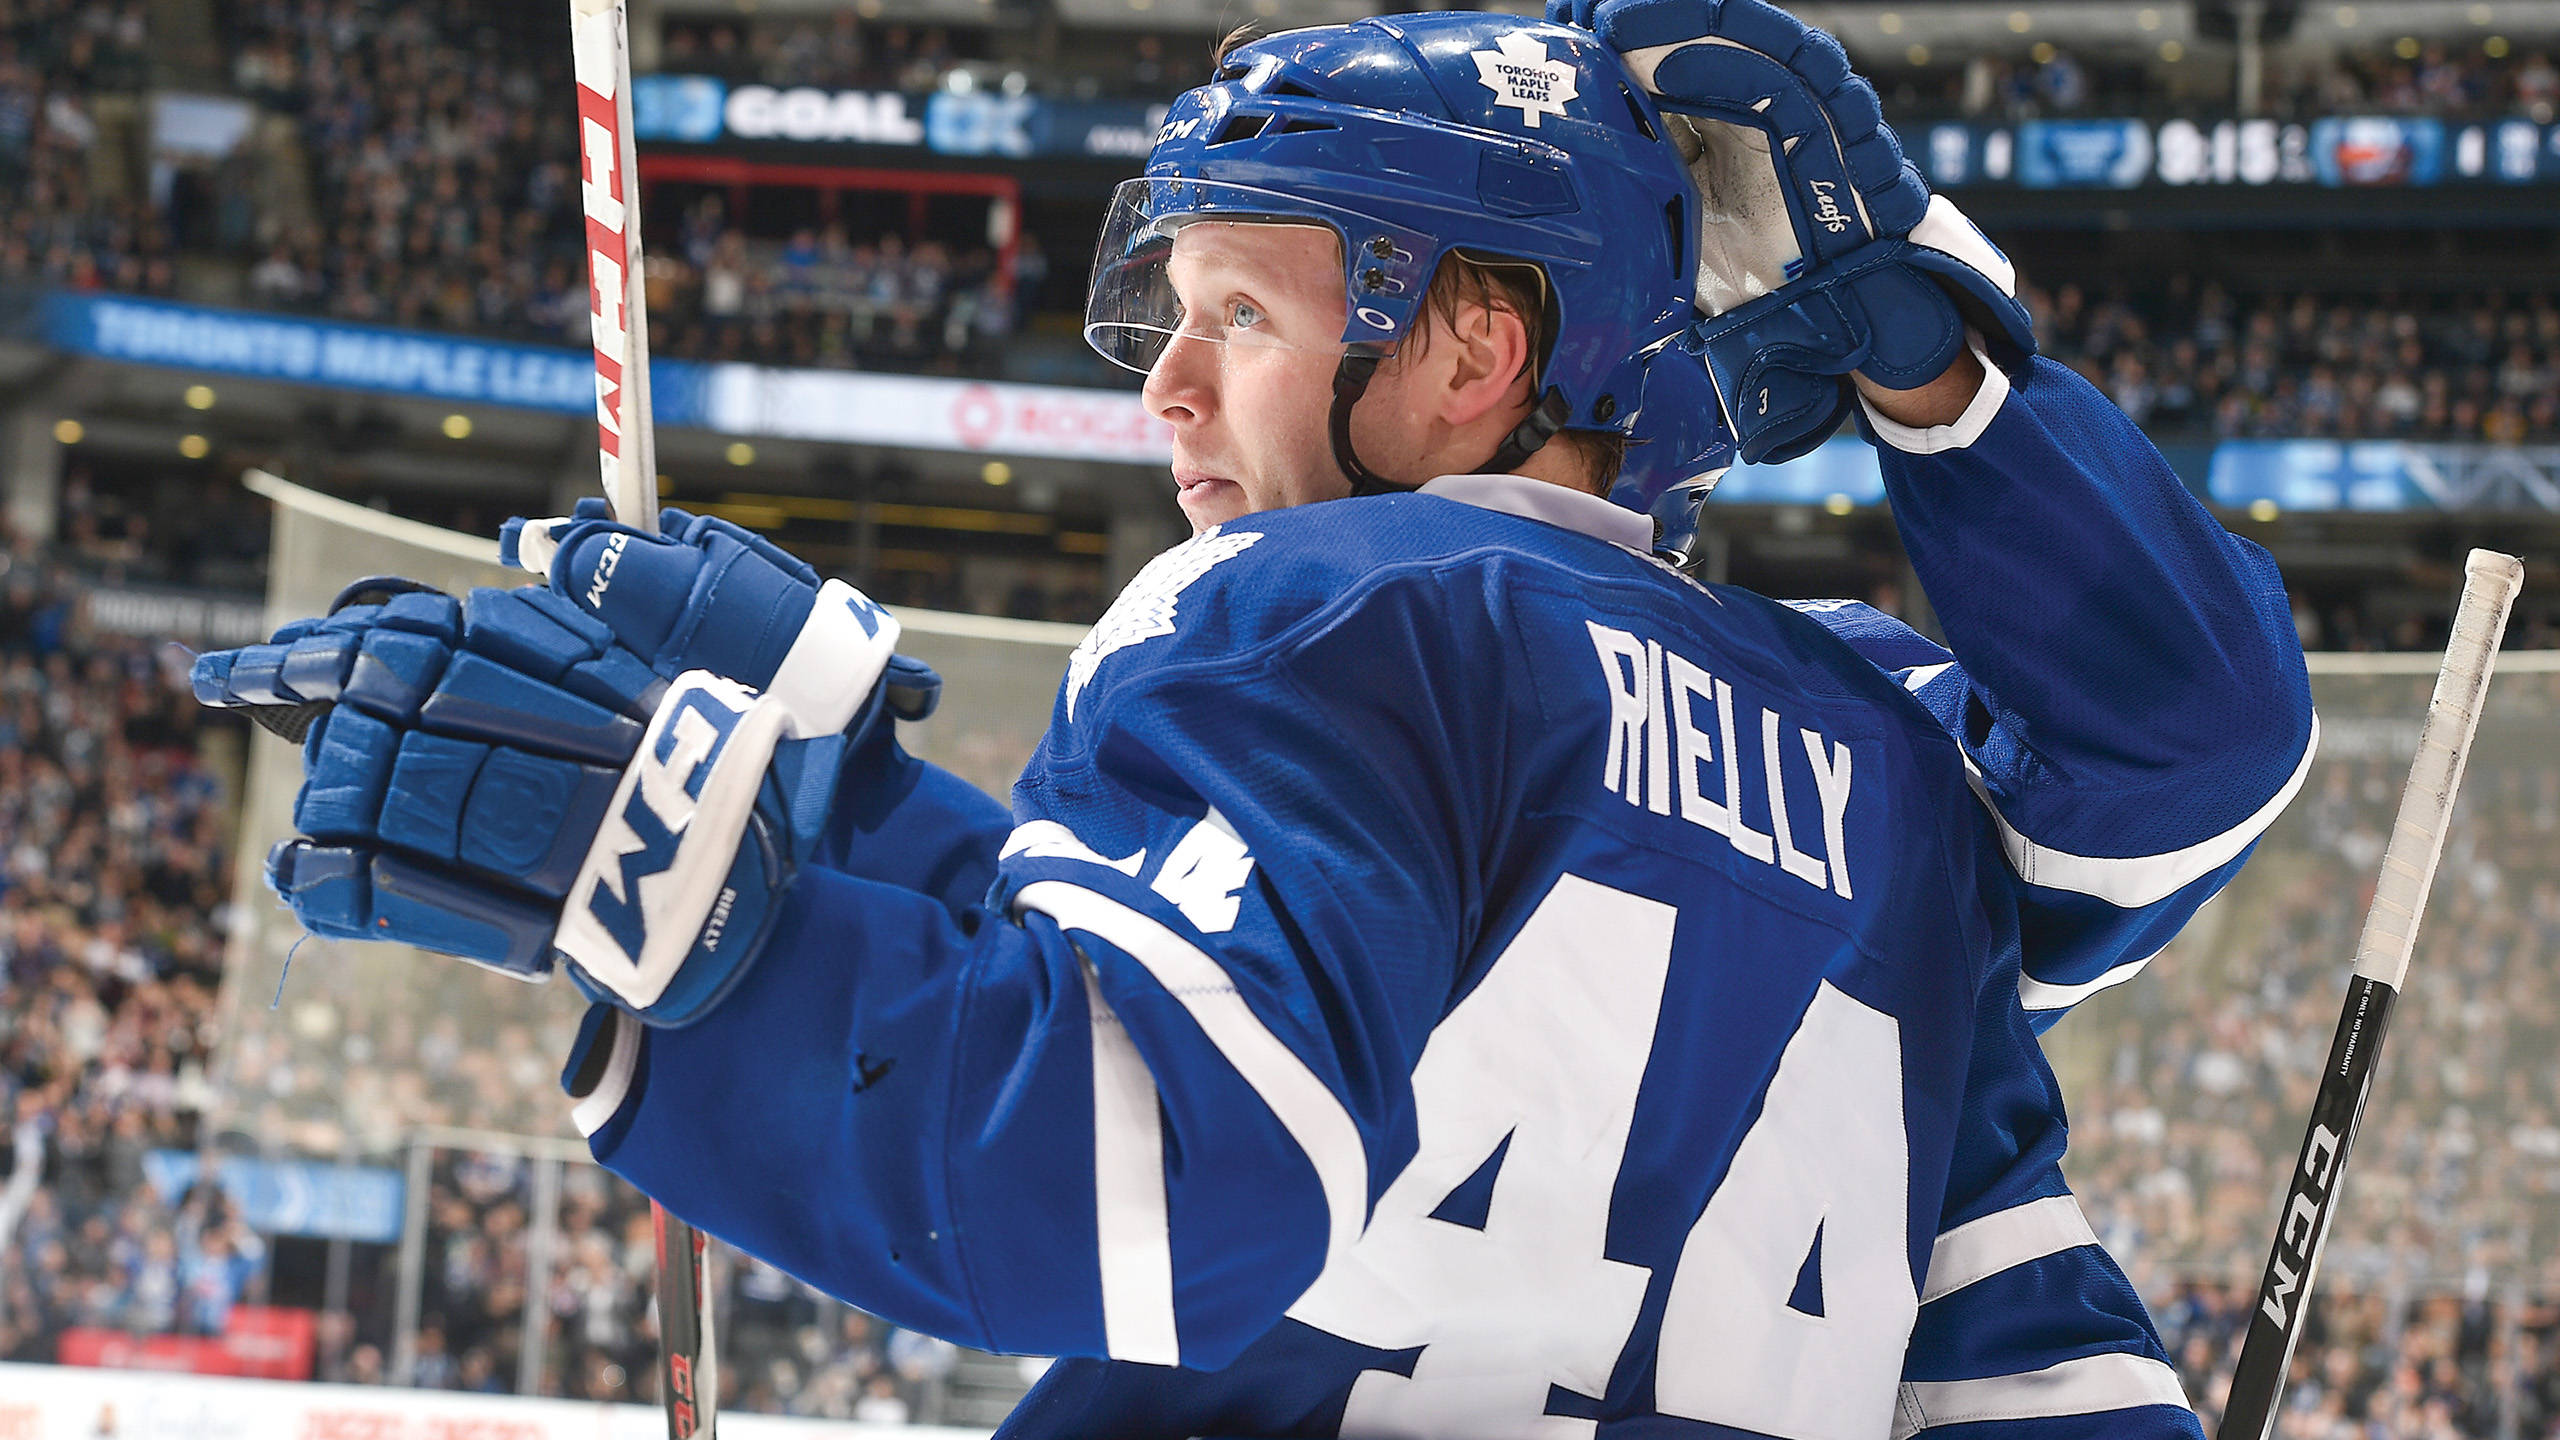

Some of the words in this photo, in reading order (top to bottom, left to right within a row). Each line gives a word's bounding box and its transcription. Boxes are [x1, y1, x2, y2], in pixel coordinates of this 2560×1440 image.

[1495, 64, 1559, 81] TORONTO
[1507, 76, 1551, 91] MAPLE
[1512, 88, 1549, 102] LEAFS
[725, 85, 924, 146] GOAL
[1151, 117, 1201, 146] CM
[2157, 118, 2279, 185] 9:15
[1809, 179, 1852, 233] Leafs
[91, 301, 317, 374] TORONTO
[322, 326, 474, 394] MAPLE
[1014, 397, 1171, 447] ROGE
[1757, 387, 1769, 416] 3
[586, 532, 630, 608] CCM
[1585, 619, 1853, 900] RIELLY
[702, 886, 738, 953] RIELLY
[2363, 979, 2375, 995] USE
[2353, 1018, 2364, 1031] NO
[2340, 1031, 2359, 1077] WARRANTY
[1284, 871, 1919, 1440] 44
[2262, 1123, 2341, 1330] CCM
